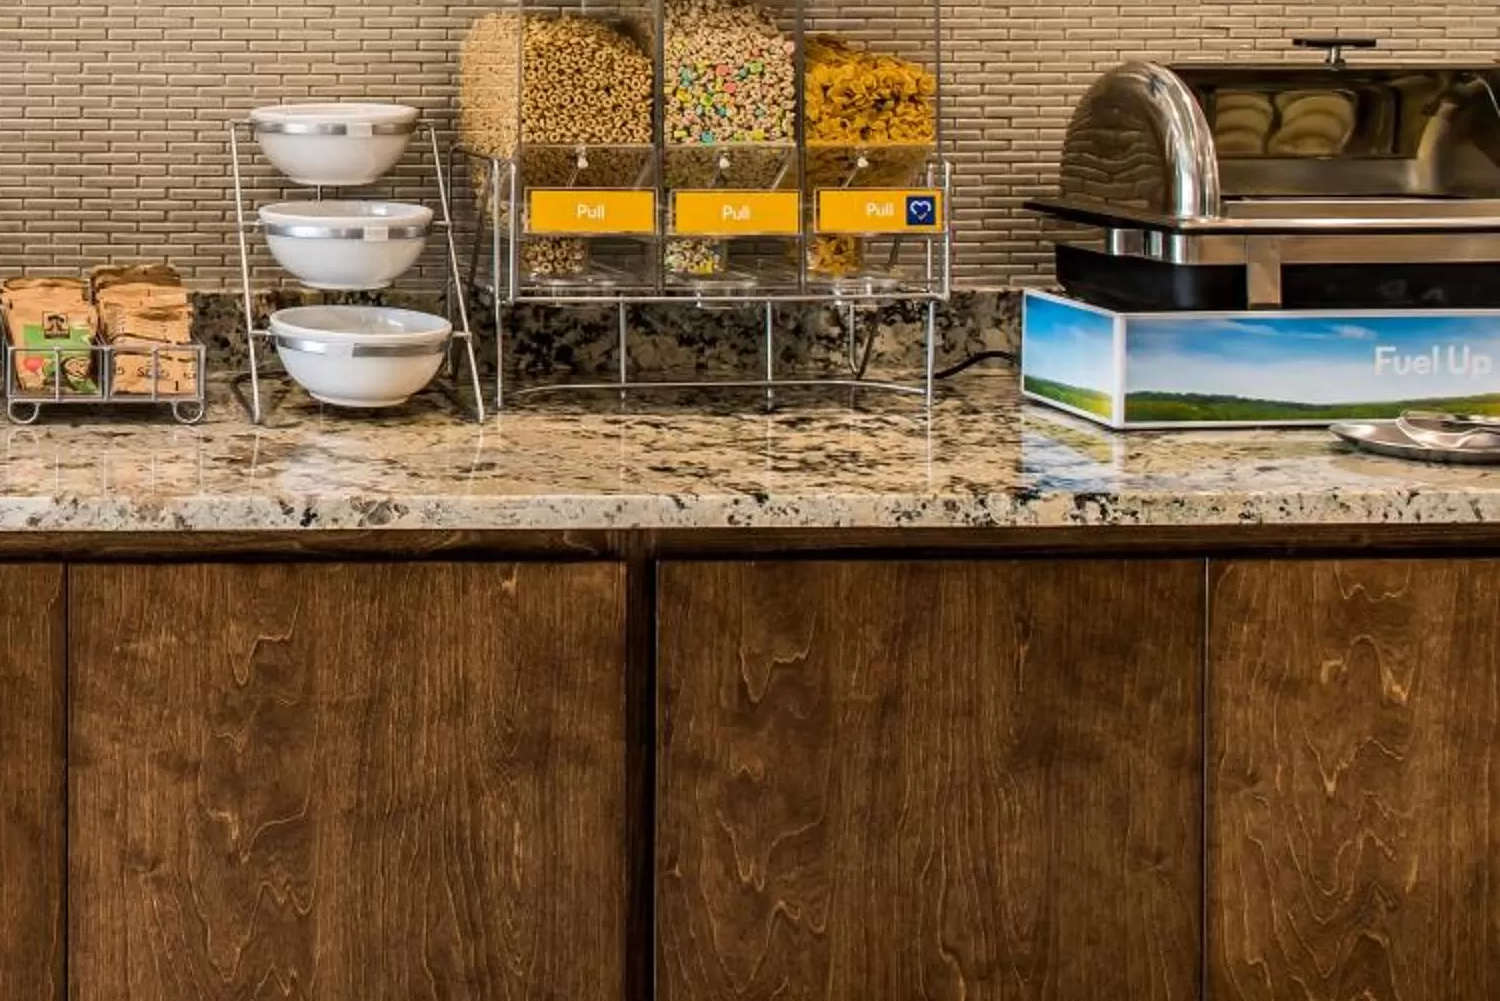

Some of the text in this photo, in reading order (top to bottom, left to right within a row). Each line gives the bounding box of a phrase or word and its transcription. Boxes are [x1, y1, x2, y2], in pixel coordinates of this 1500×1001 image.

[576, 204, 605, 220] Pull
[722, 205, 750, 221] Pull
[866, 203, 894, 217] Pull
[1374, 345, 1492, 381] Fuel Up
